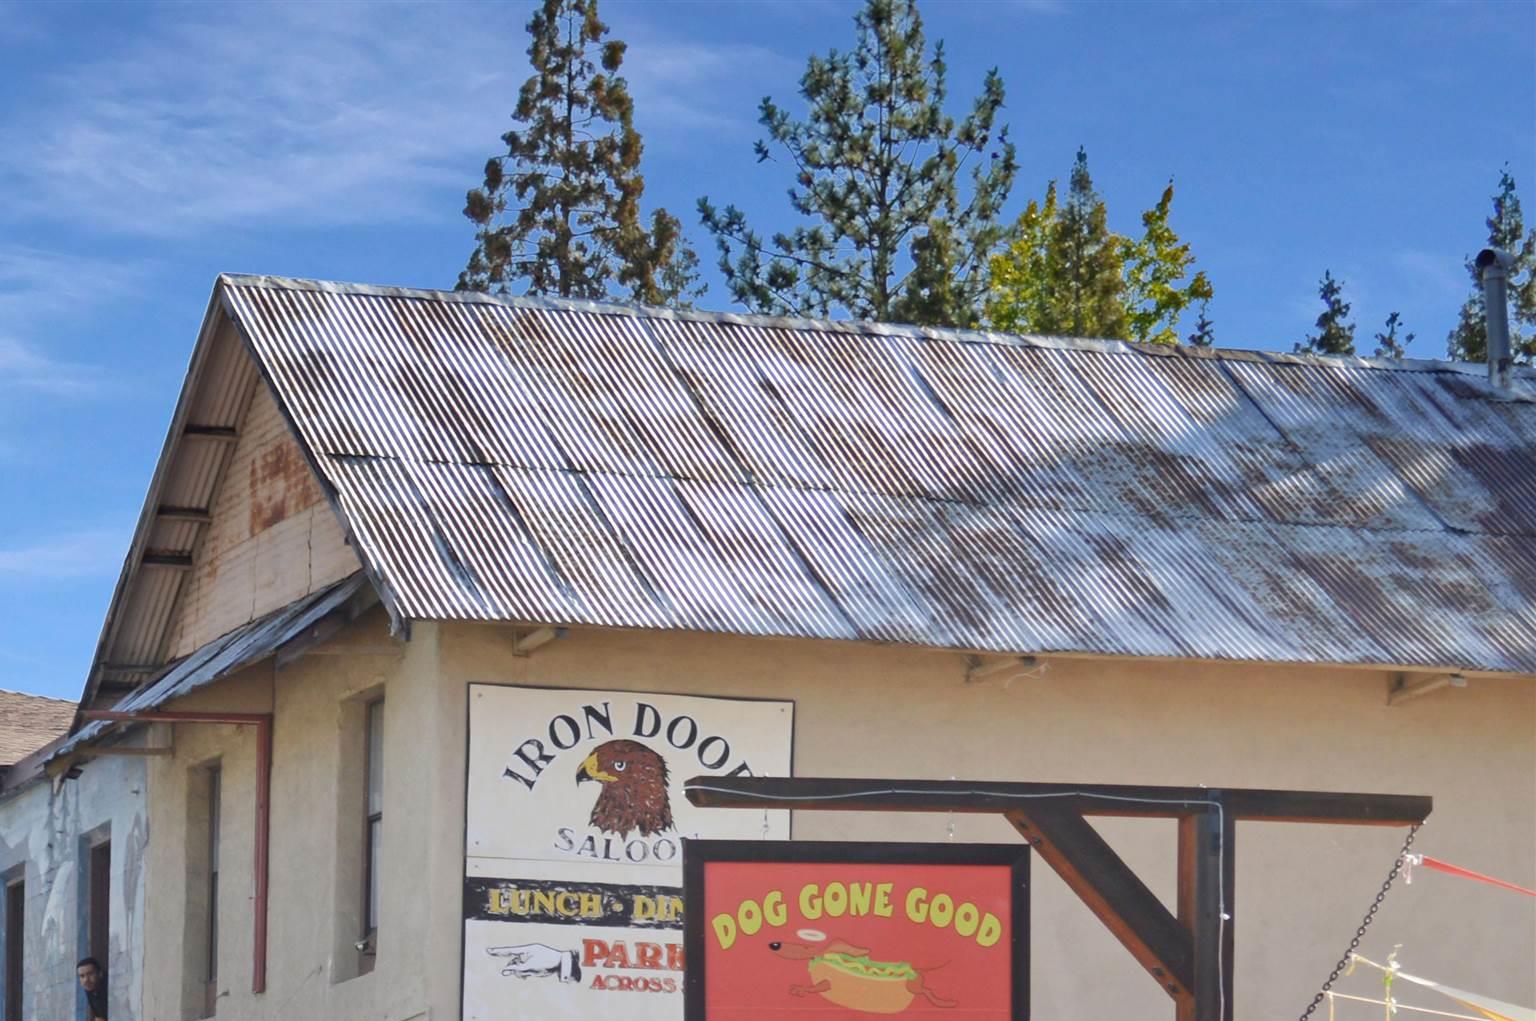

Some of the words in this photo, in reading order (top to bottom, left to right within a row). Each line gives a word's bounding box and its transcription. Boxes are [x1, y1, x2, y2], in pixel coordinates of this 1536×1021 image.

[503, 702, 614, 791] IRON
[554, 828, 686, 864] SALOO
[489, 888, 604, 918] LUNCH
[712, 890, 788, 950] DOG
[799, 877, 894, 920] GONE
[906, 887, 1002, 947] GOOD
[591, 974, 678, 993] ACROSS
